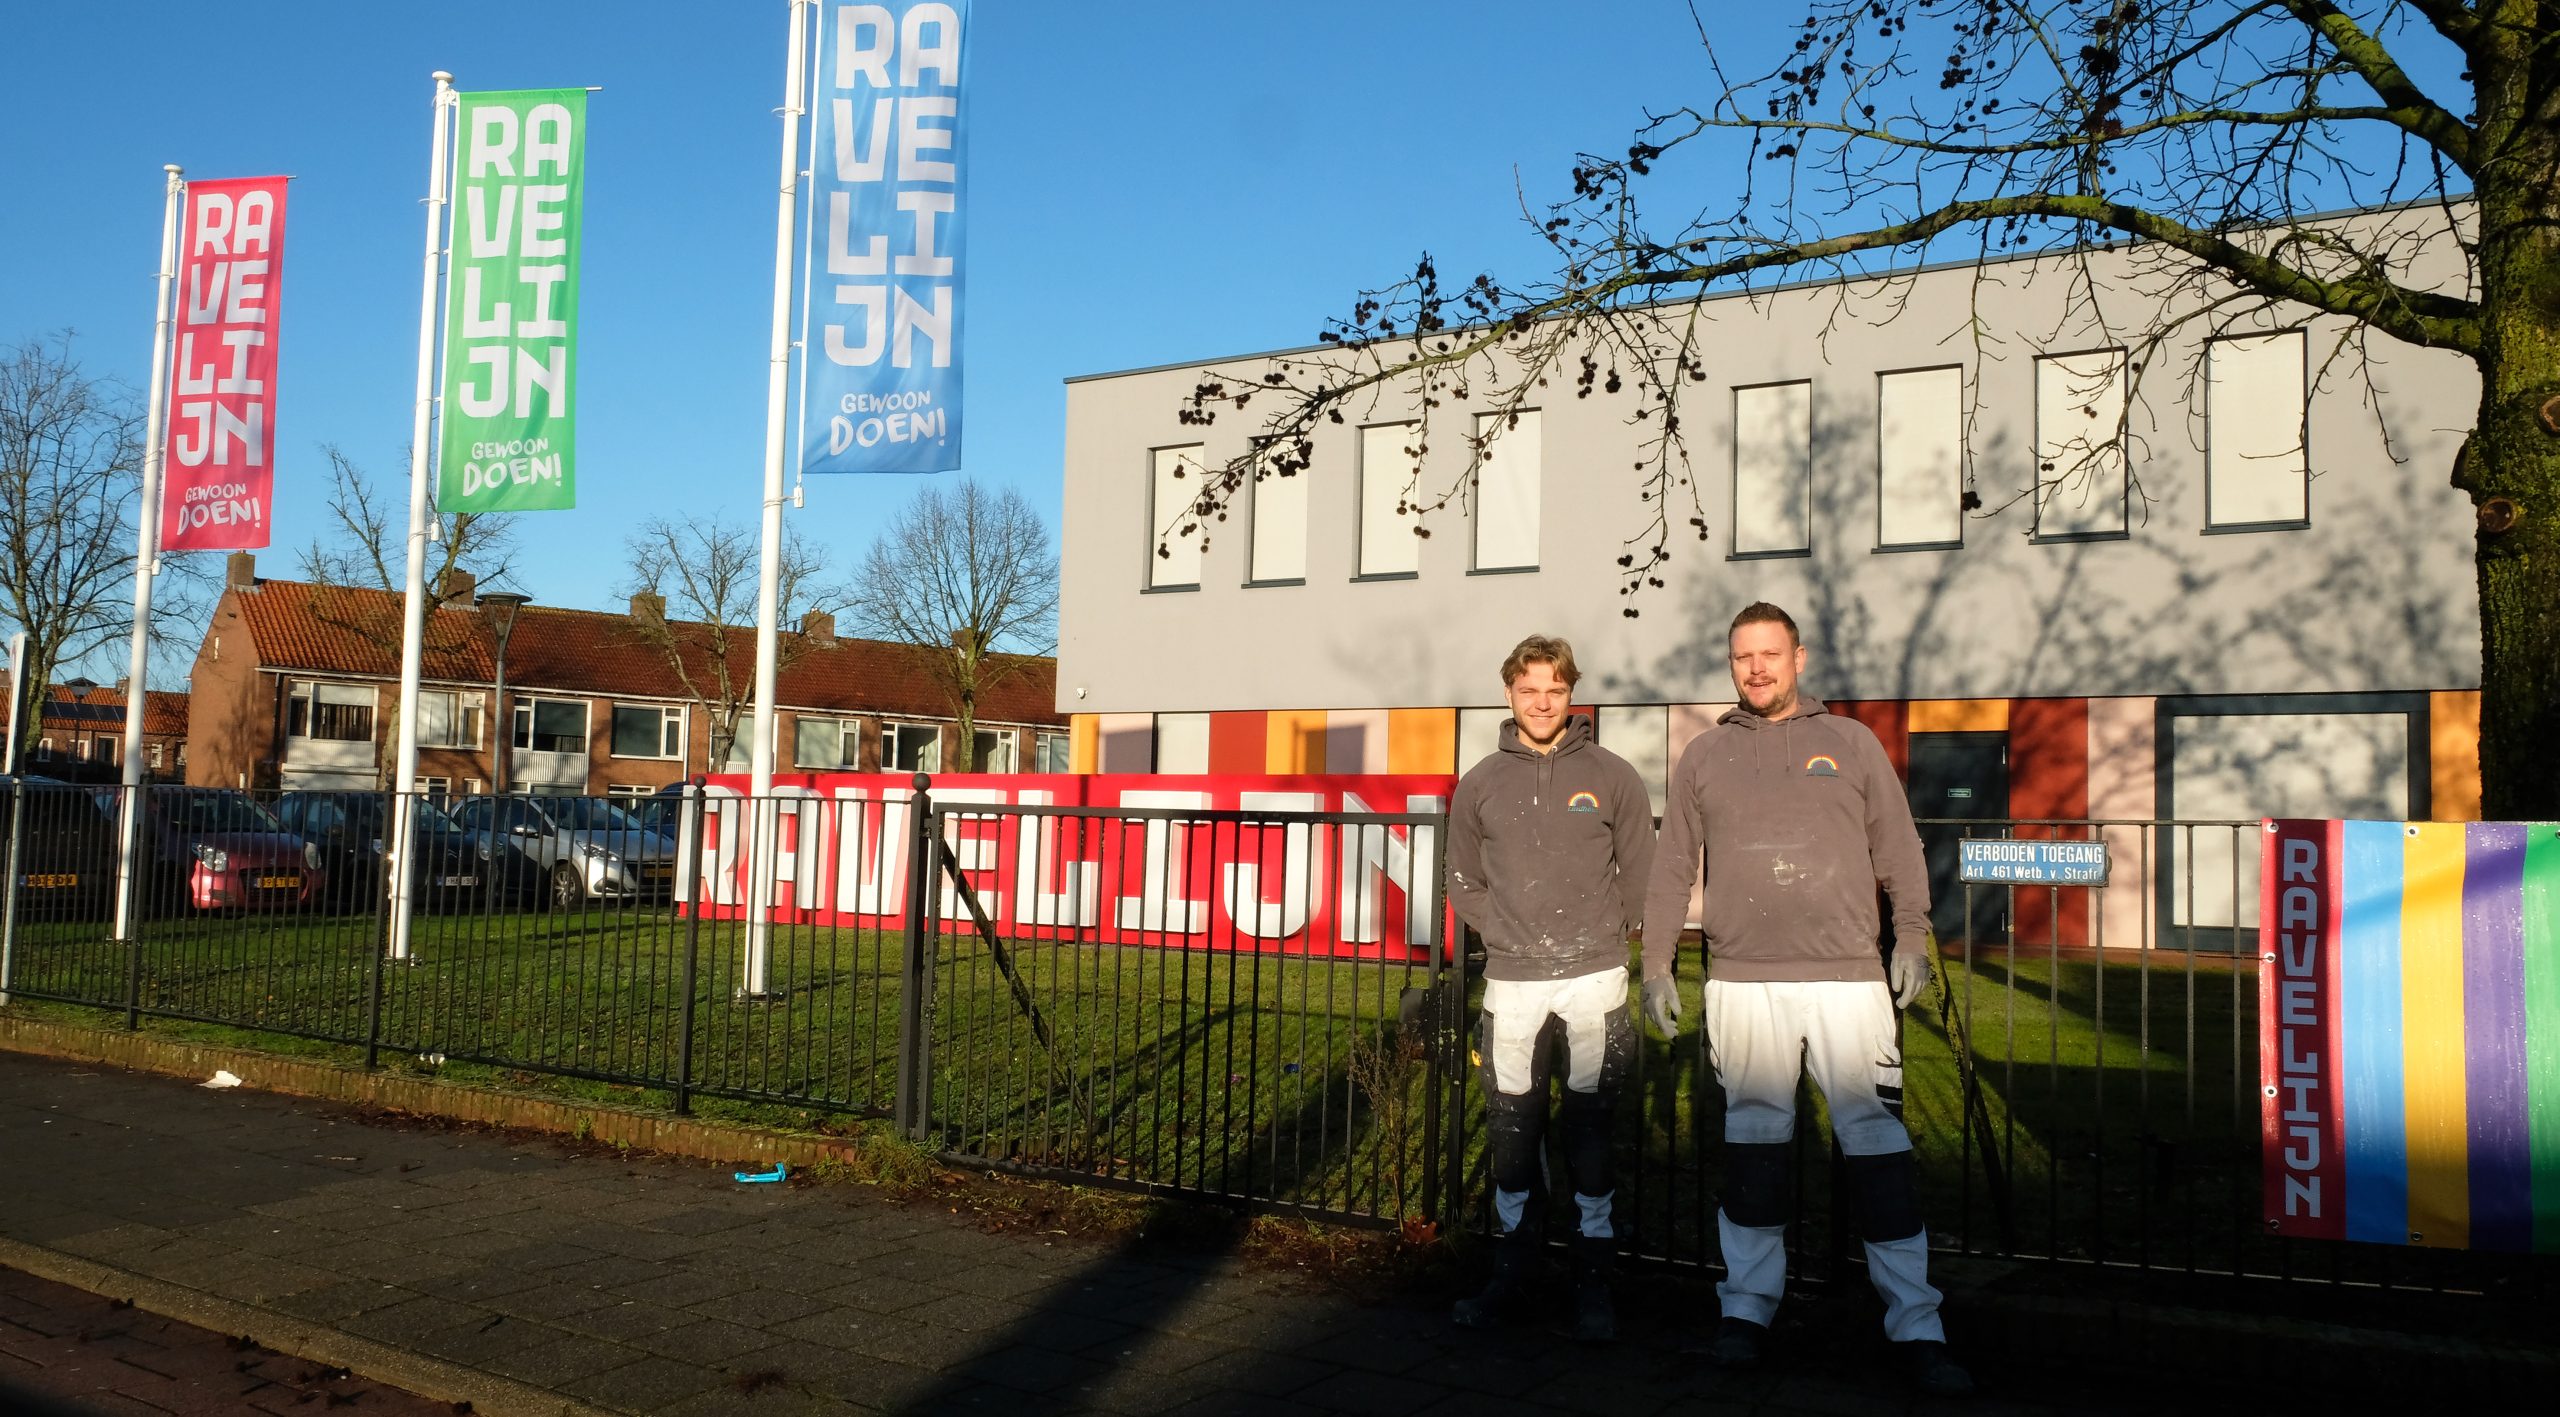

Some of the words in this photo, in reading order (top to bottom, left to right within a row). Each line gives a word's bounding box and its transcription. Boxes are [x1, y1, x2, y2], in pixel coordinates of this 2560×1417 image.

[840, 390, 931, 415] GEWOON
[829, 407, 946, 456] DOEN!
[471, 437, 549, 461] GEWOON
[462, 453, 562, 497] DOEN!
[185, 483, 247, 505] GEWOON
[177, 497, 261, 536] DOEN!
[675, 784, 1446, 945] RAVELIJN
[1966, 844, 2035, 862] VERBODEN
[2041, 846, 2102, 864] TOEGANG
[1991, 865, 2010, 878] 461
[2014, 866, 2046, 879] Wetb.
[2050, 869, 2061, 880] v.
[2281, 838, 2321, 1218] RAVELIJN
